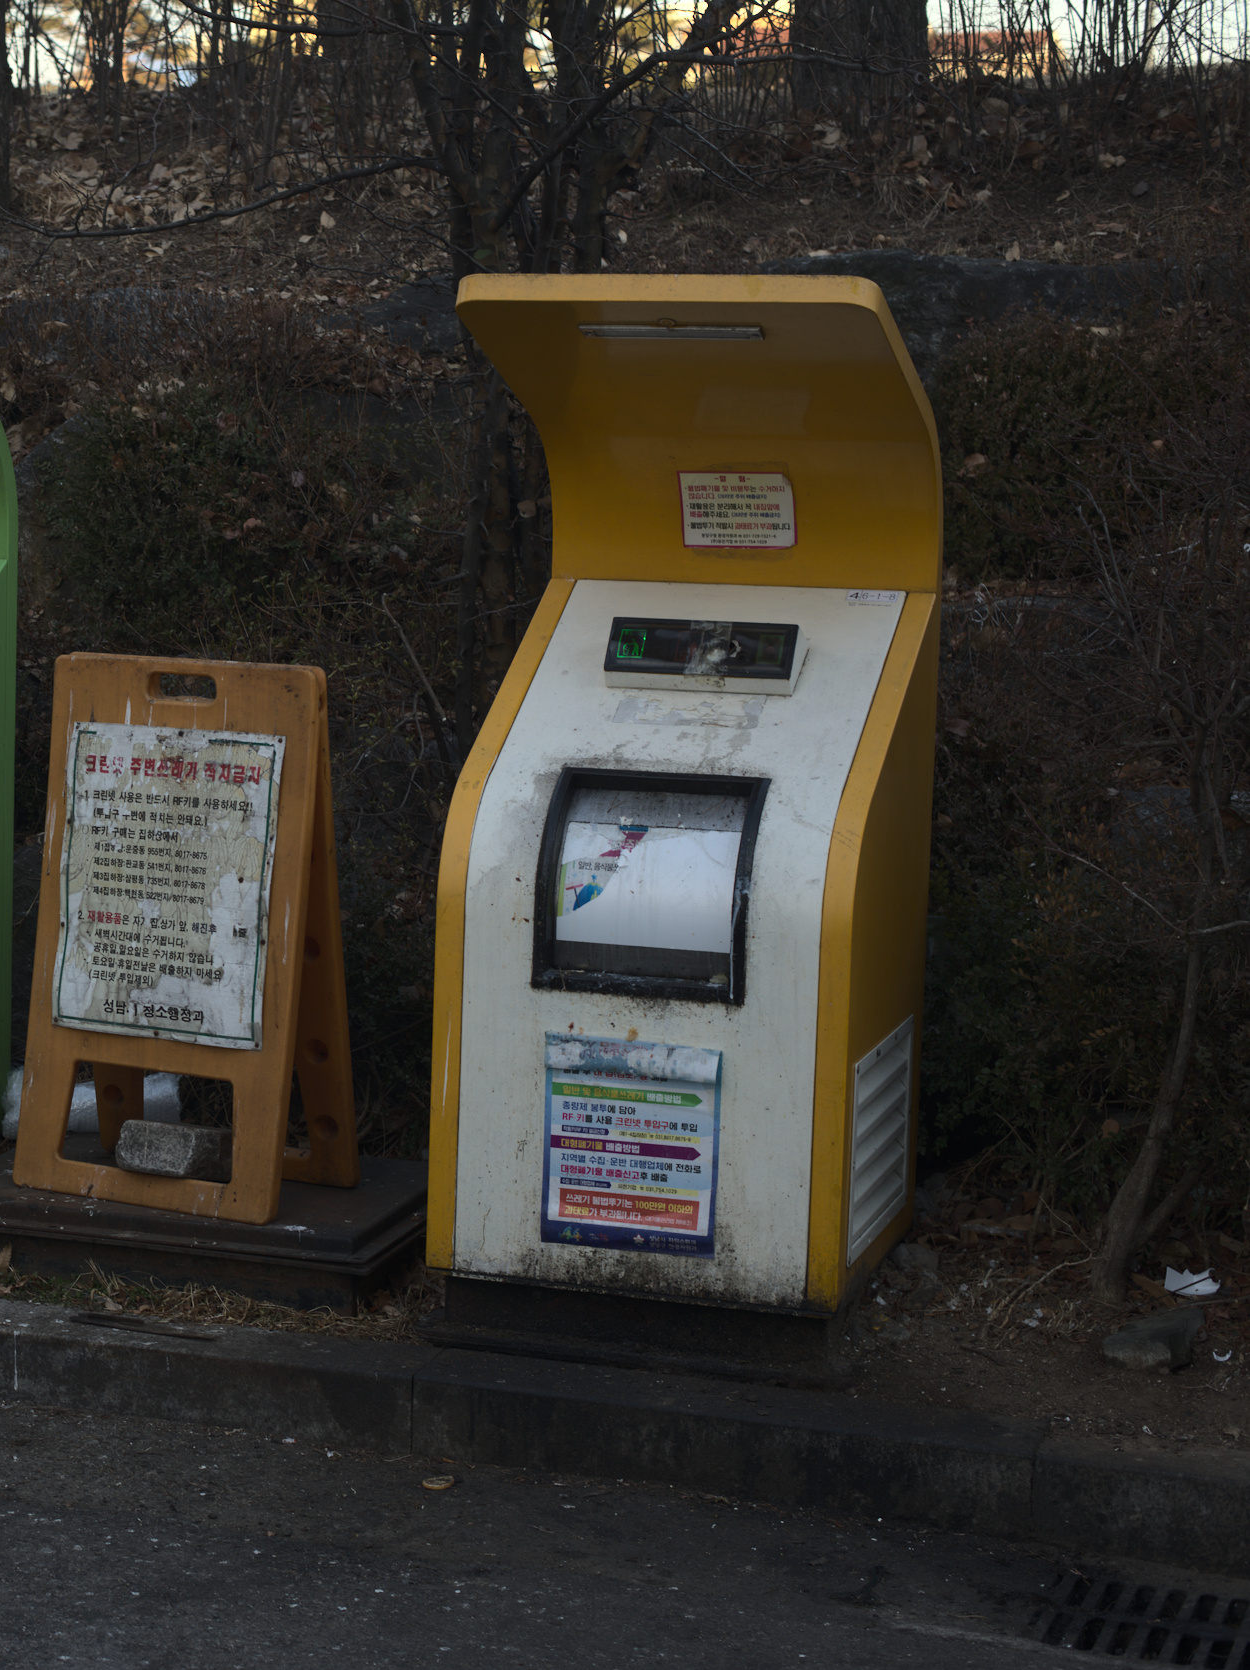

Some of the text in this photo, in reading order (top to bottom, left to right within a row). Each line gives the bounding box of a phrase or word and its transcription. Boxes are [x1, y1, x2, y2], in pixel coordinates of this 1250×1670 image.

[93, 790, 115, 802] 크린넷
[119, 791, 142, 803] 사용은
[147, 794, 170, 806] 반드시
[173, 796, 199, 806] RF키를
[150, 811, 173, 825] 적치는
[91, 826, 108, 836] RF키
[112, 827, 135, 838] 구매는
[175, 850, 207, 860] 8017-8675
[175, 865, 206, 875] 8017-8676
[173, 880, 205, 890] 8017-8678
[173, 894, 204, 905] 8017-8679
[78, 911, 85, 920] 2.
[88, 910, 129, 925] 재활용품은
[94, 928, 141, 944] 새벽시간대에
[153, 948, 185, 962] 수거하지
[89, 969, 115, 982] (크린넷
[159, 964, 192, 977] 배출하지
[196, 969, 222, 981] 마세요
[562, 1085, 681, 1105] 일반 및 음식물쓰레기 배출방법
[562, 1100, 636, 1115] 종량제 봉투에 담아
[562, 1113, 697, 1133] RF 키를 사용 크린넷 투입구에 투입
[561, 1153, 586, 1164] 지역별
[630, 1160, 672, 1172] 대행업체에
[676, 1163, 701, 1174] 전화로
[566, 1194, 693, 1215] 쓰레기 불법투기는 100만원 이하의
[564, 1205, 598, 1217] 과태료가
[600, 1208, 643, 1222] 부과됩니다.
